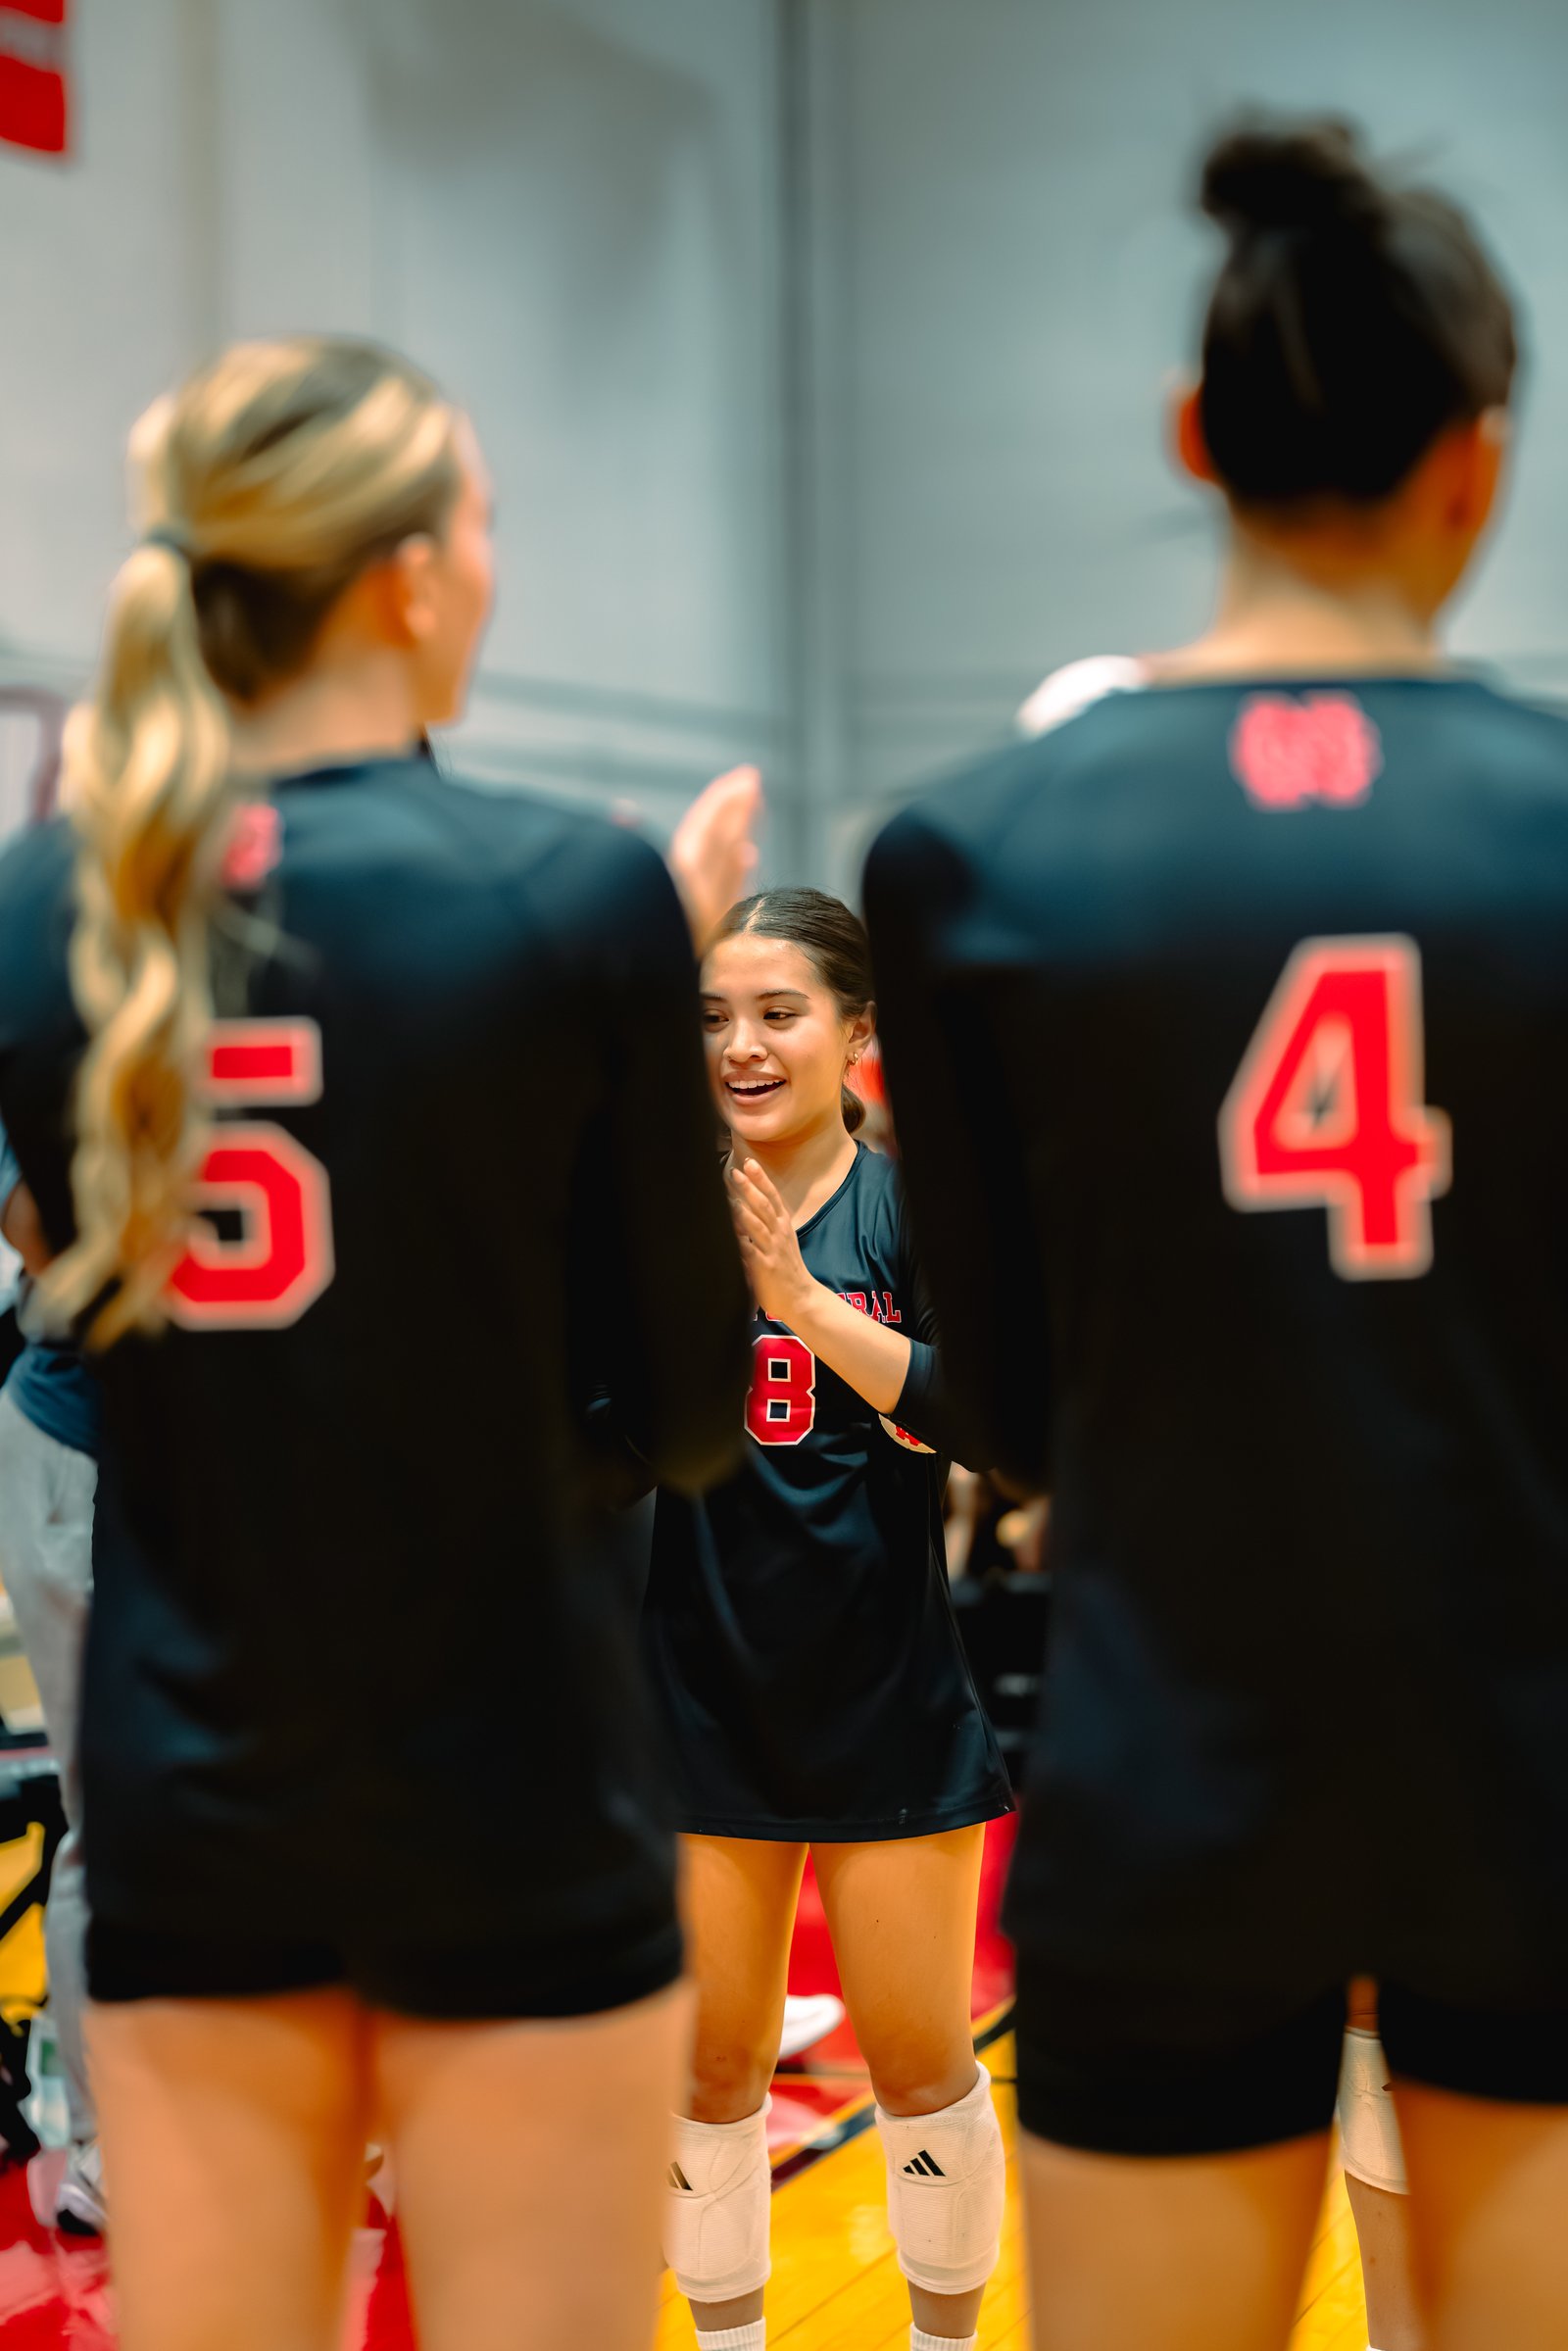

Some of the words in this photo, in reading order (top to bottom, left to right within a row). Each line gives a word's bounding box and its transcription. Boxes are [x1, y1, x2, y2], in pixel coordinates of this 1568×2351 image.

[169, 1015, 334, 1331] 5
[1218, 934, 1452, 1281] 4
[744, 1334, 815, 1445] 8
[836, 1291, 902, 1323] RAL
